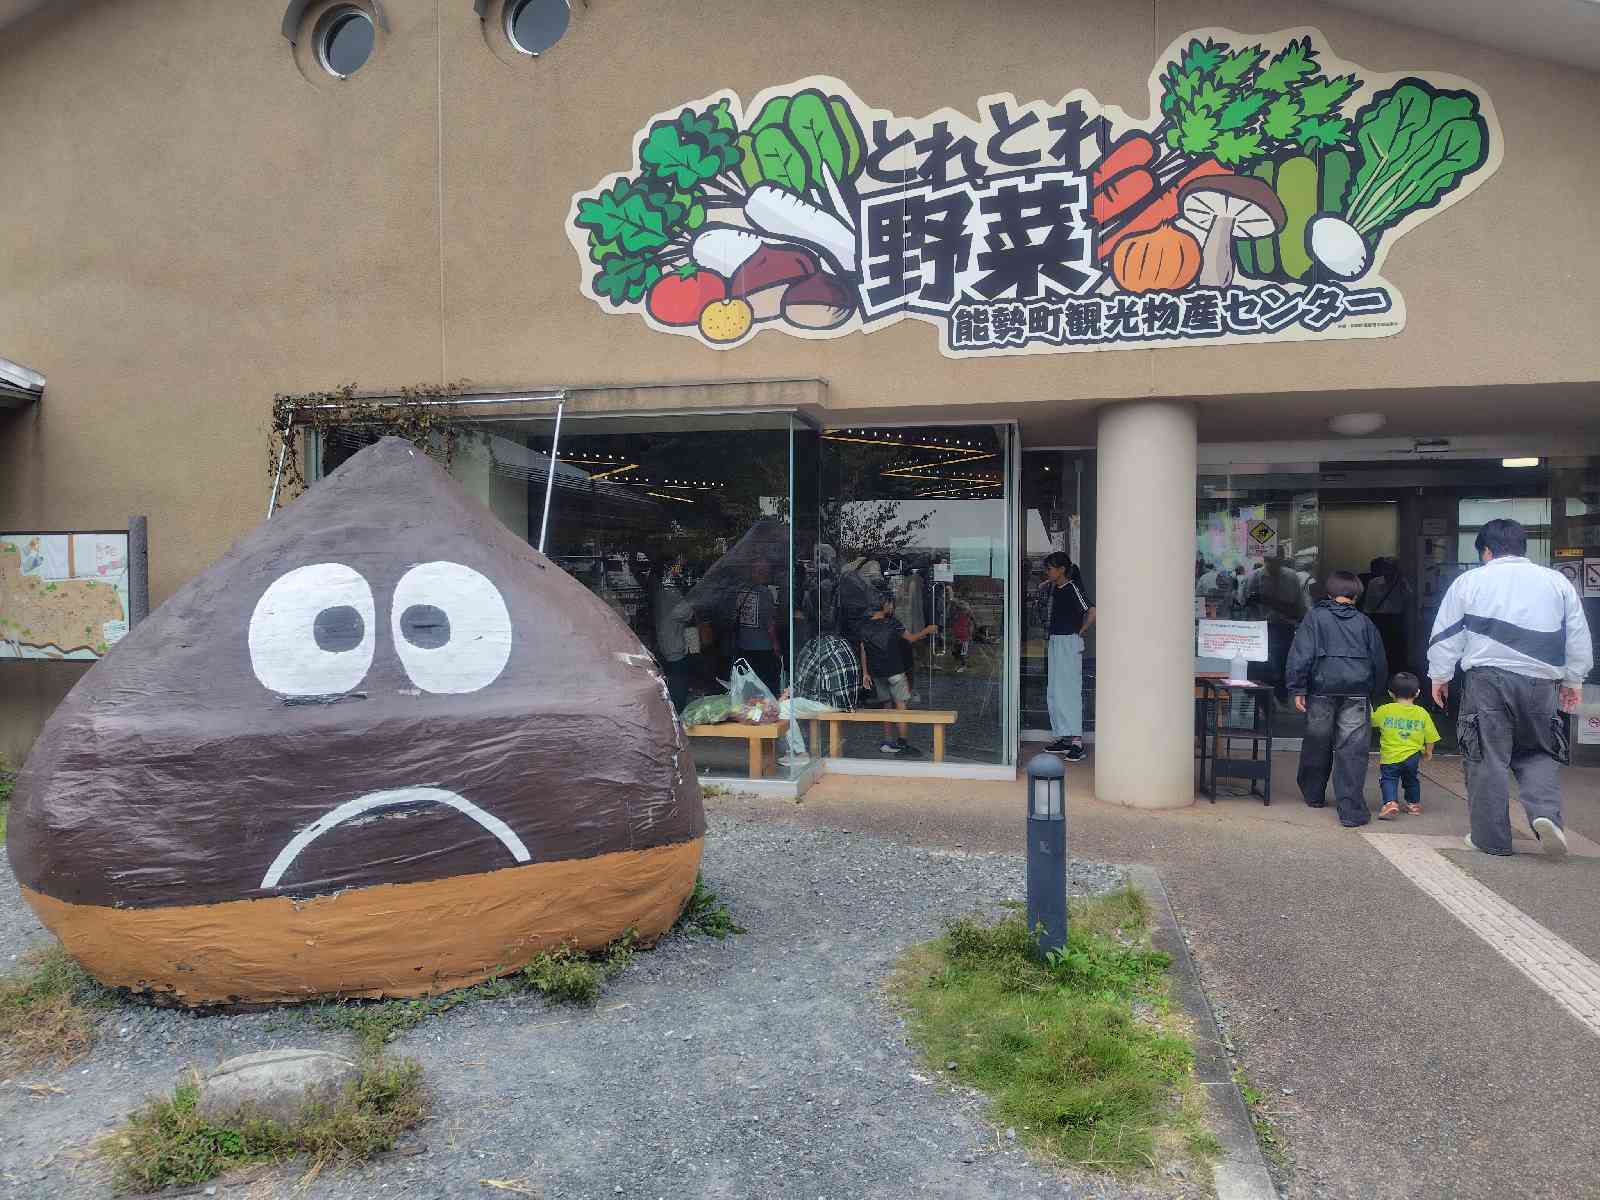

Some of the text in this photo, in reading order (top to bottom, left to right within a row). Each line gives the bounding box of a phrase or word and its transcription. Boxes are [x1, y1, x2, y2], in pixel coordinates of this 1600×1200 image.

[866, 100, 1113, 192] とれとれ
[866, 178, 1097, 308] 野菜
[955, 286, 1386, 344] 能勢町観光物産センター
